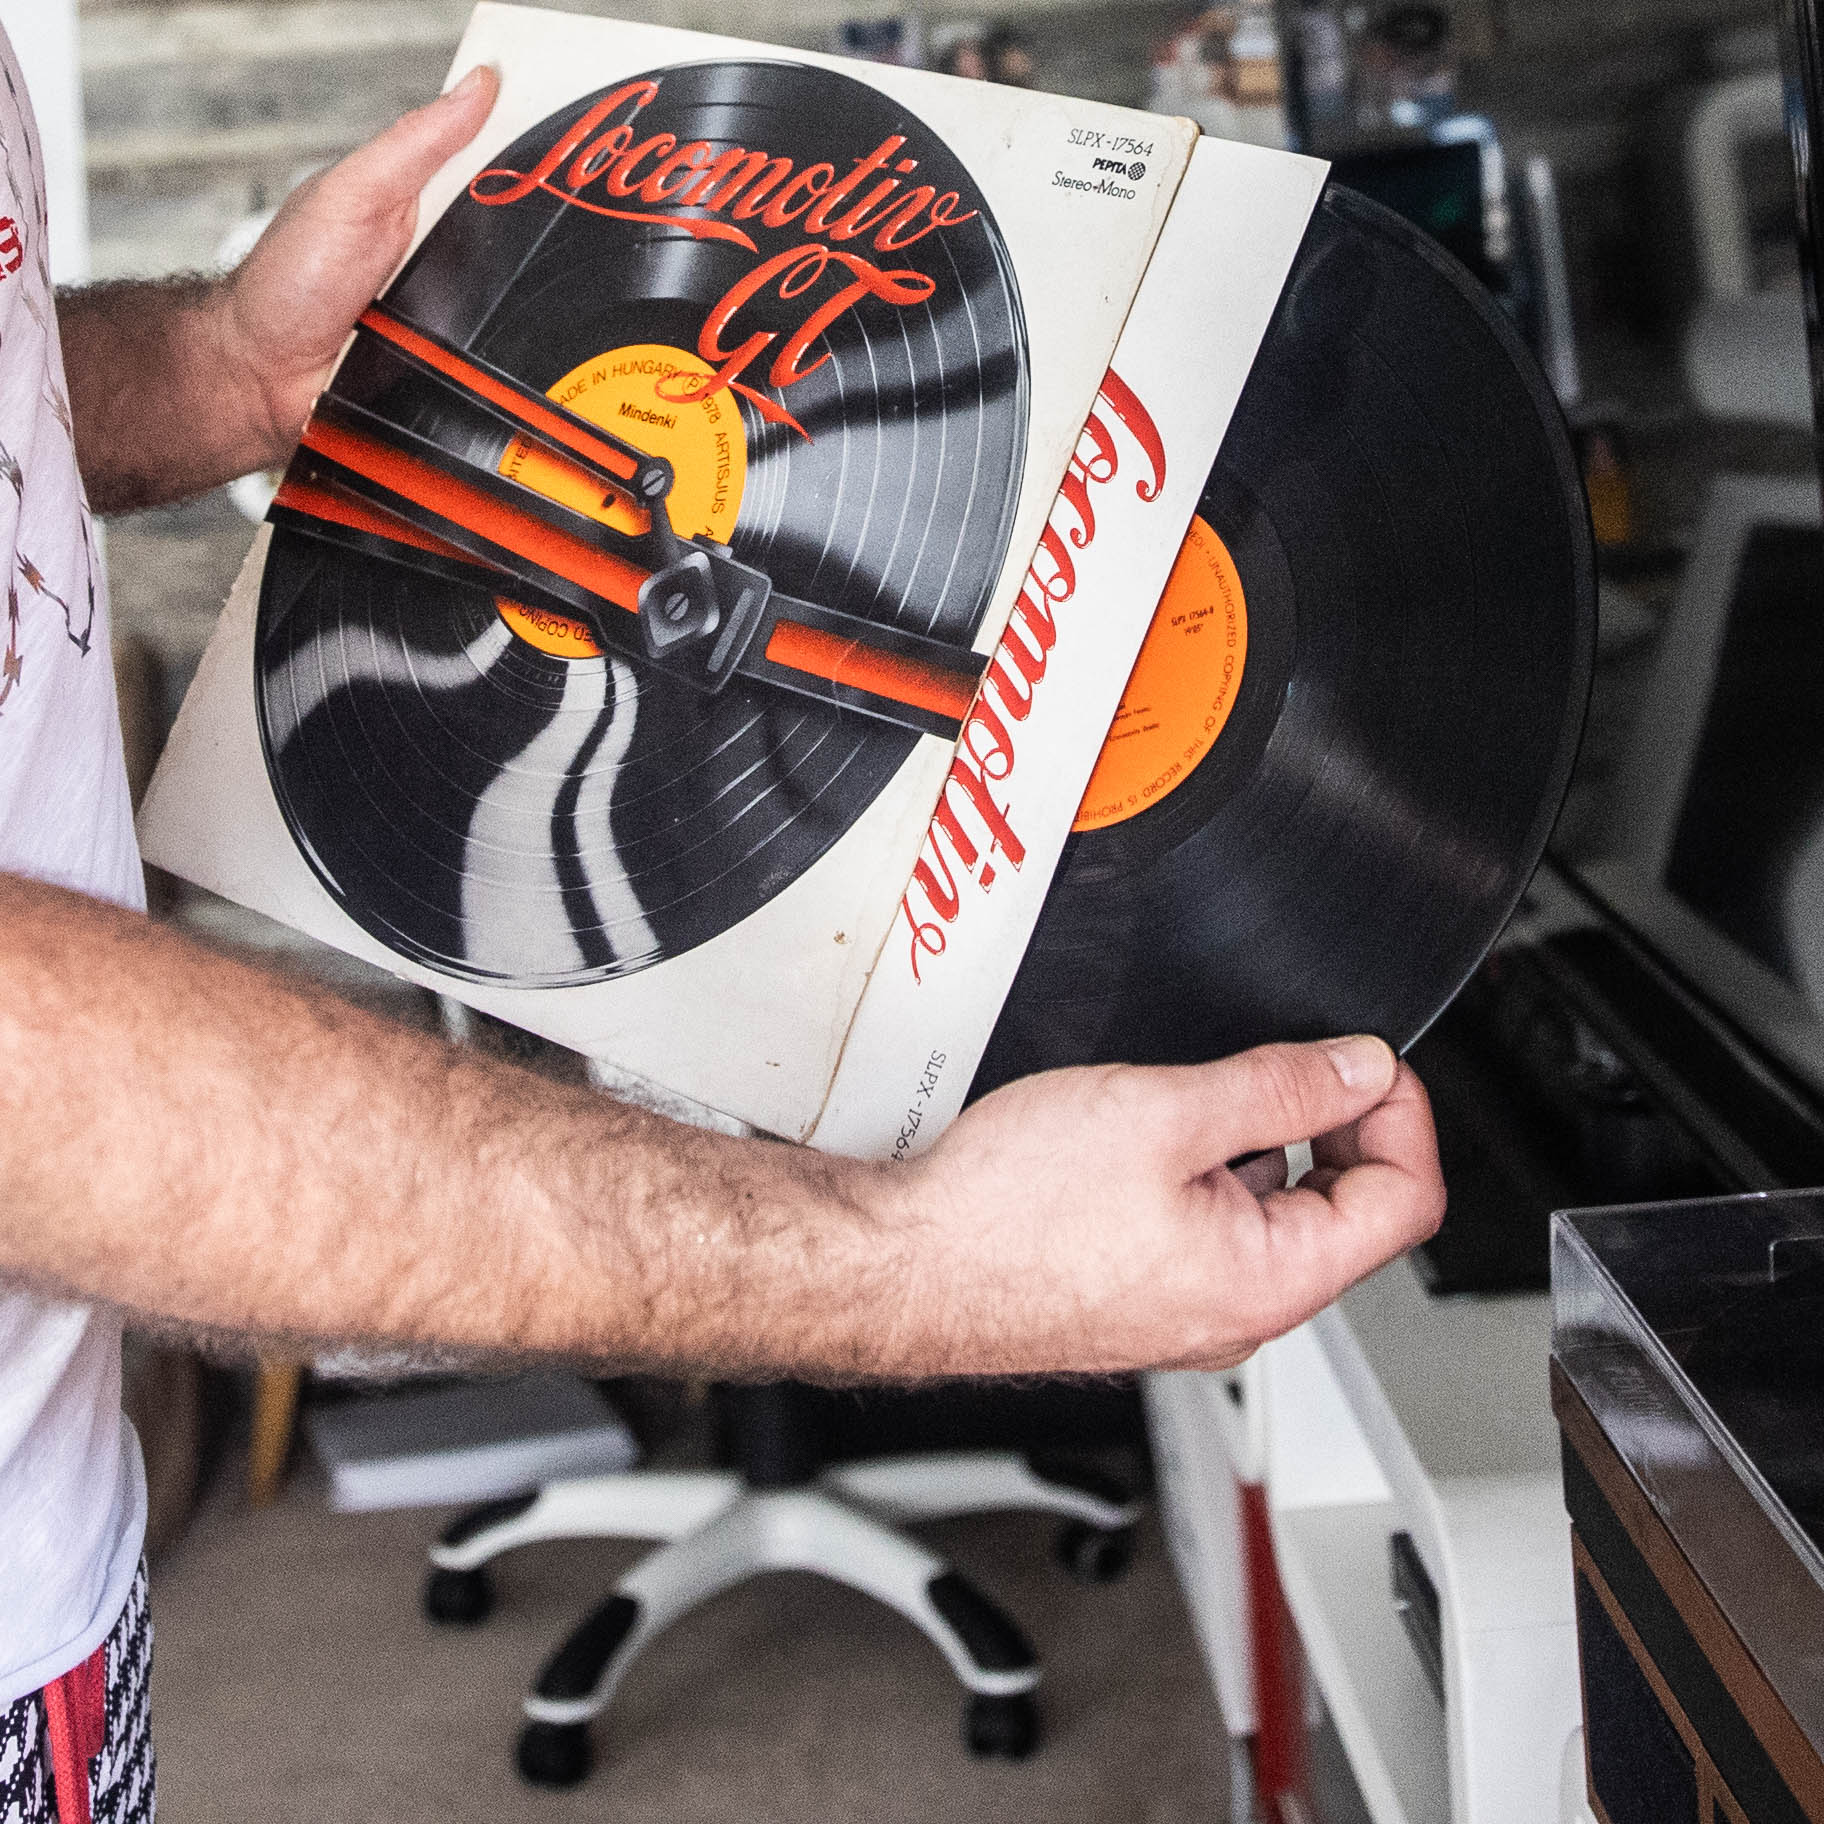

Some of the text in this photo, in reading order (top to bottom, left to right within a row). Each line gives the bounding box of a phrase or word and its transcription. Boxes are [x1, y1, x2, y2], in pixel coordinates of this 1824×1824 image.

[469, 81, 979, 253] Locomotiv
[1092, 157, 1127, 175] PEPITA
[591, 369, 607, 384] IN
[711, 431, 731, 515] ARTISJUS
[618, 402, 678, 430] Mindenki
[1207, 557, 1237, 648] UNAUTHORIZED
